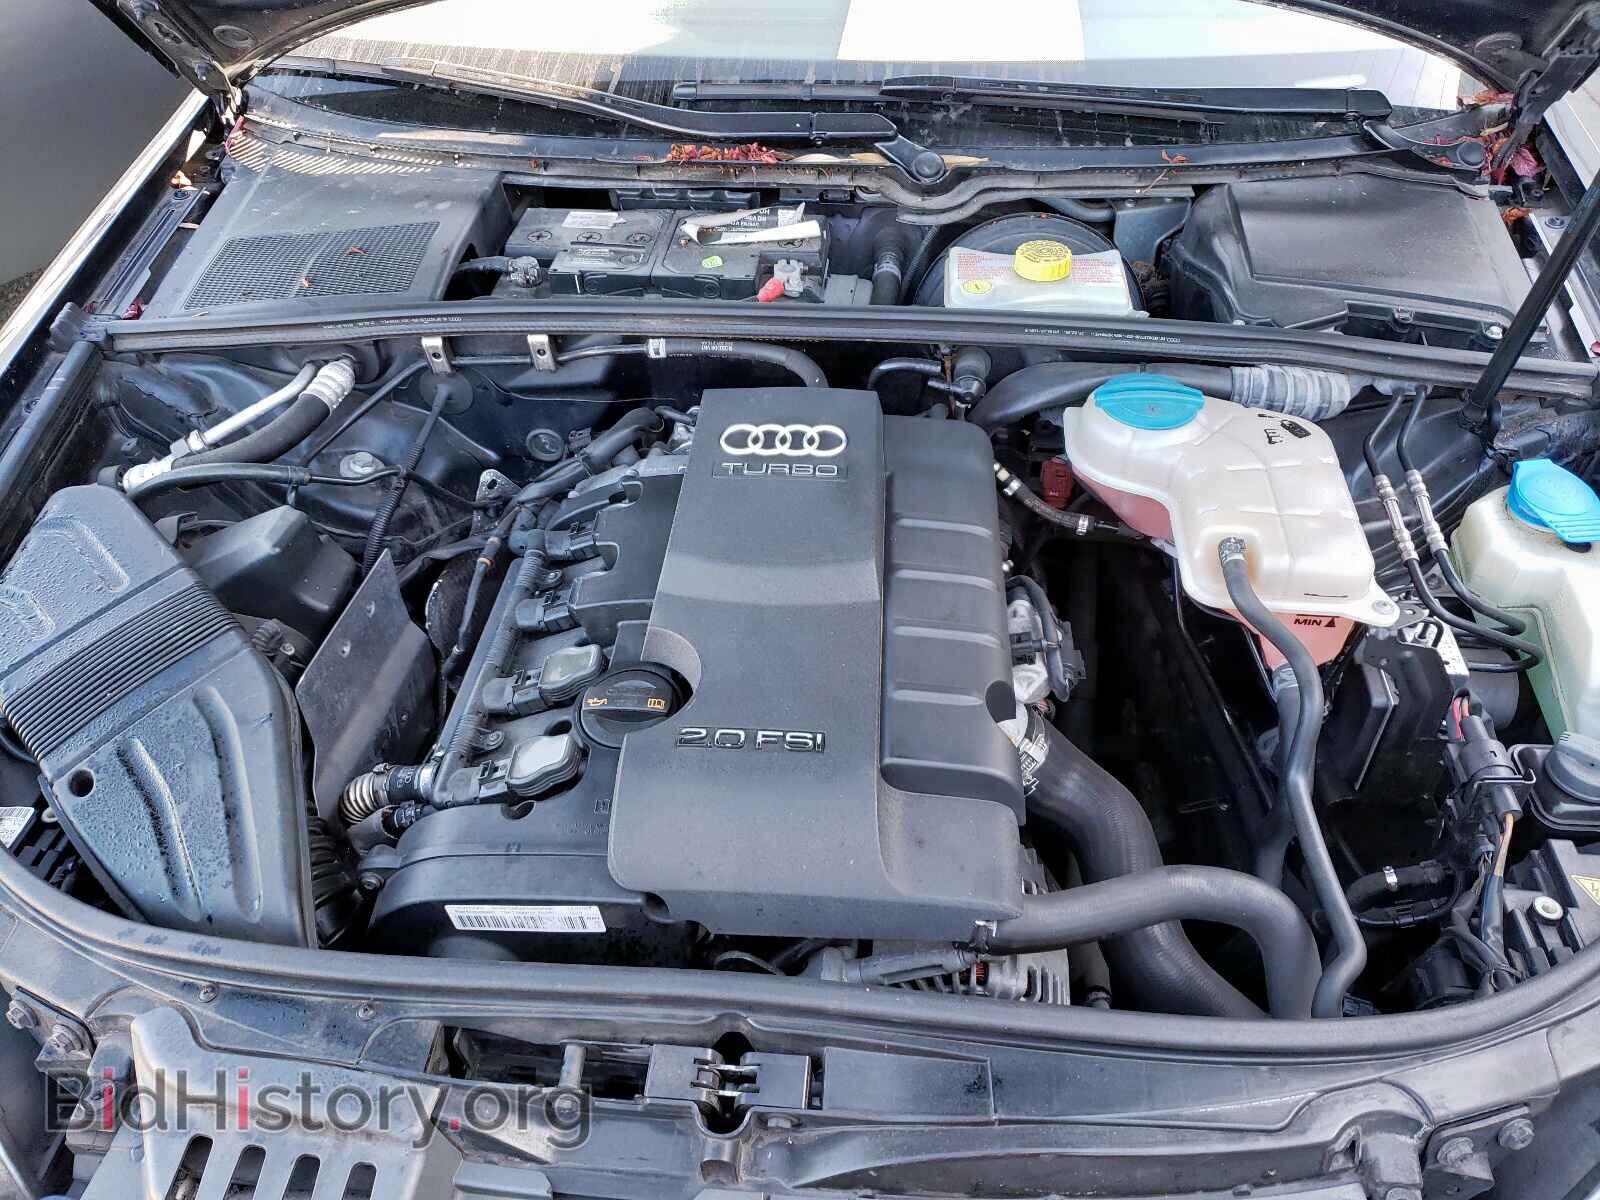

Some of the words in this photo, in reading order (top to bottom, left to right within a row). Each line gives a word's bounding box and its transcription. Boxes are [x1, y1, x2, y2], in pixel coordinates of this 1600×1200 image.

[721, 462, 839, 477] TURBO
[1293, 618, 1322, 626] MIN
[677, 727, 746, 749] 2.0
[755, 730, 825, 752] FSI
